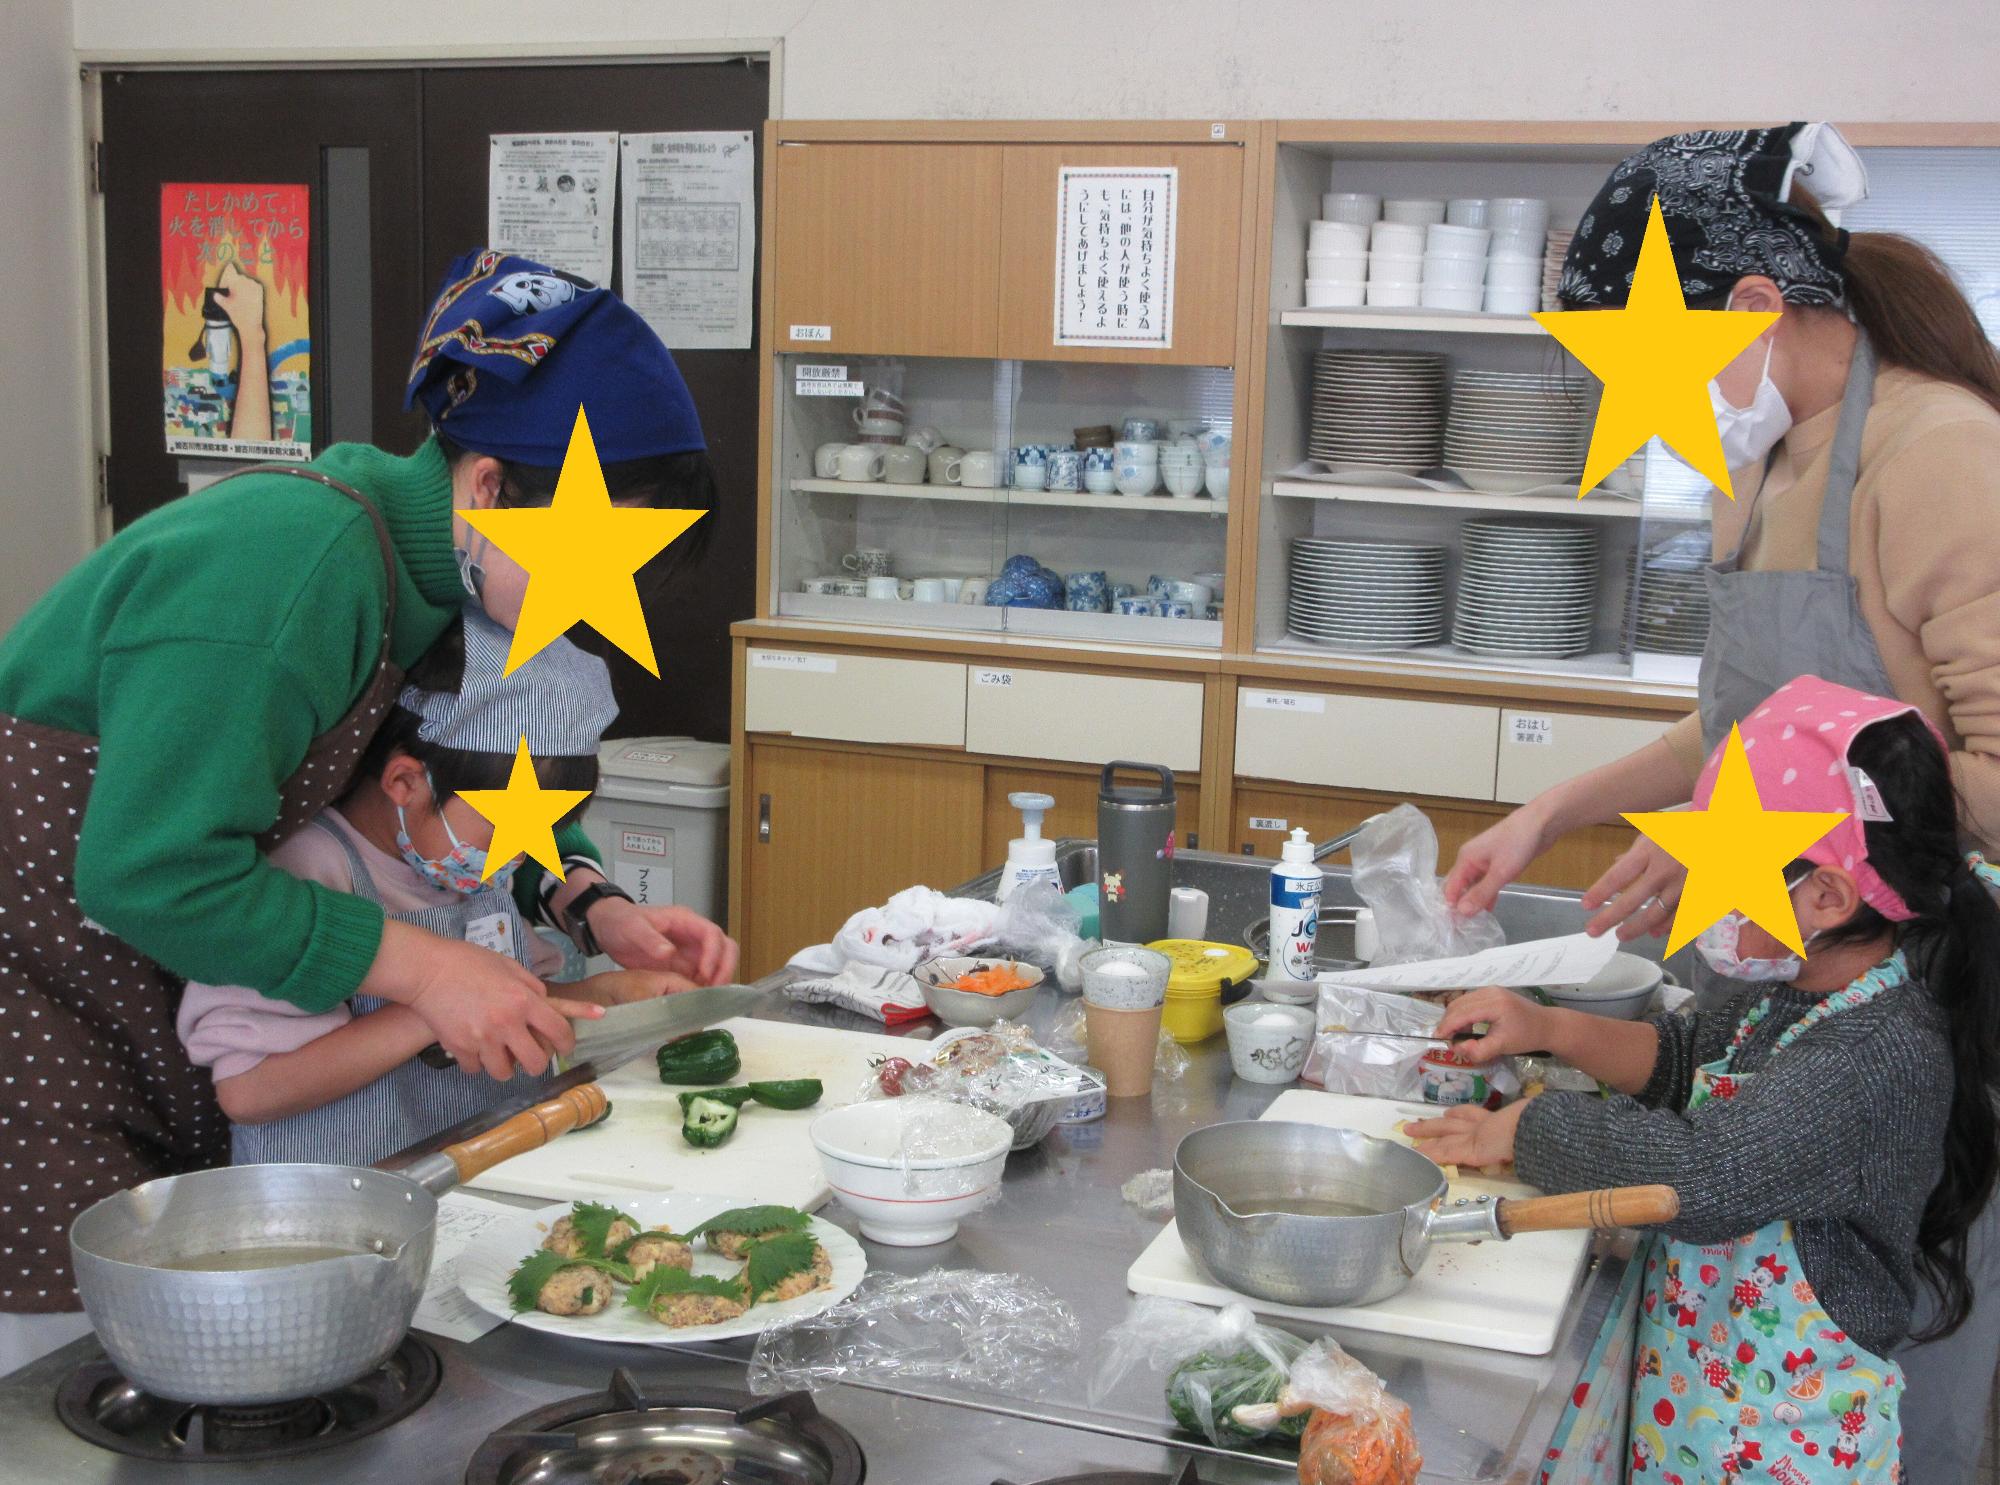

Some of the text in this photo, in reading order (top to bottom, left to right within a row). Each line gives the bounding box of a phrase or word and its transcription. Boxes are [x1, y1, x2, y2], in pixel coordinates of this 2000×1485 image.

[184, 191, 288, 214] たしかめて。
[169, 216, 304, 239] 火を消してから
[196, 240, 276, 265] 次のこと
[1096, 189, 1111, 329] も、気持ちよく使えるよ
[1117, 189, 1132, 329] には、他の人が使う時に
[1138, 188, 1155, 330] 自分が気持ちよく使う為
[796, 327, 824, 338] おぼん
[802, 367, 840, 378] 開放厳禁
[981, 672, 1012, 685] ごみ袋
[1515, 718, 1550, 731] おはし
